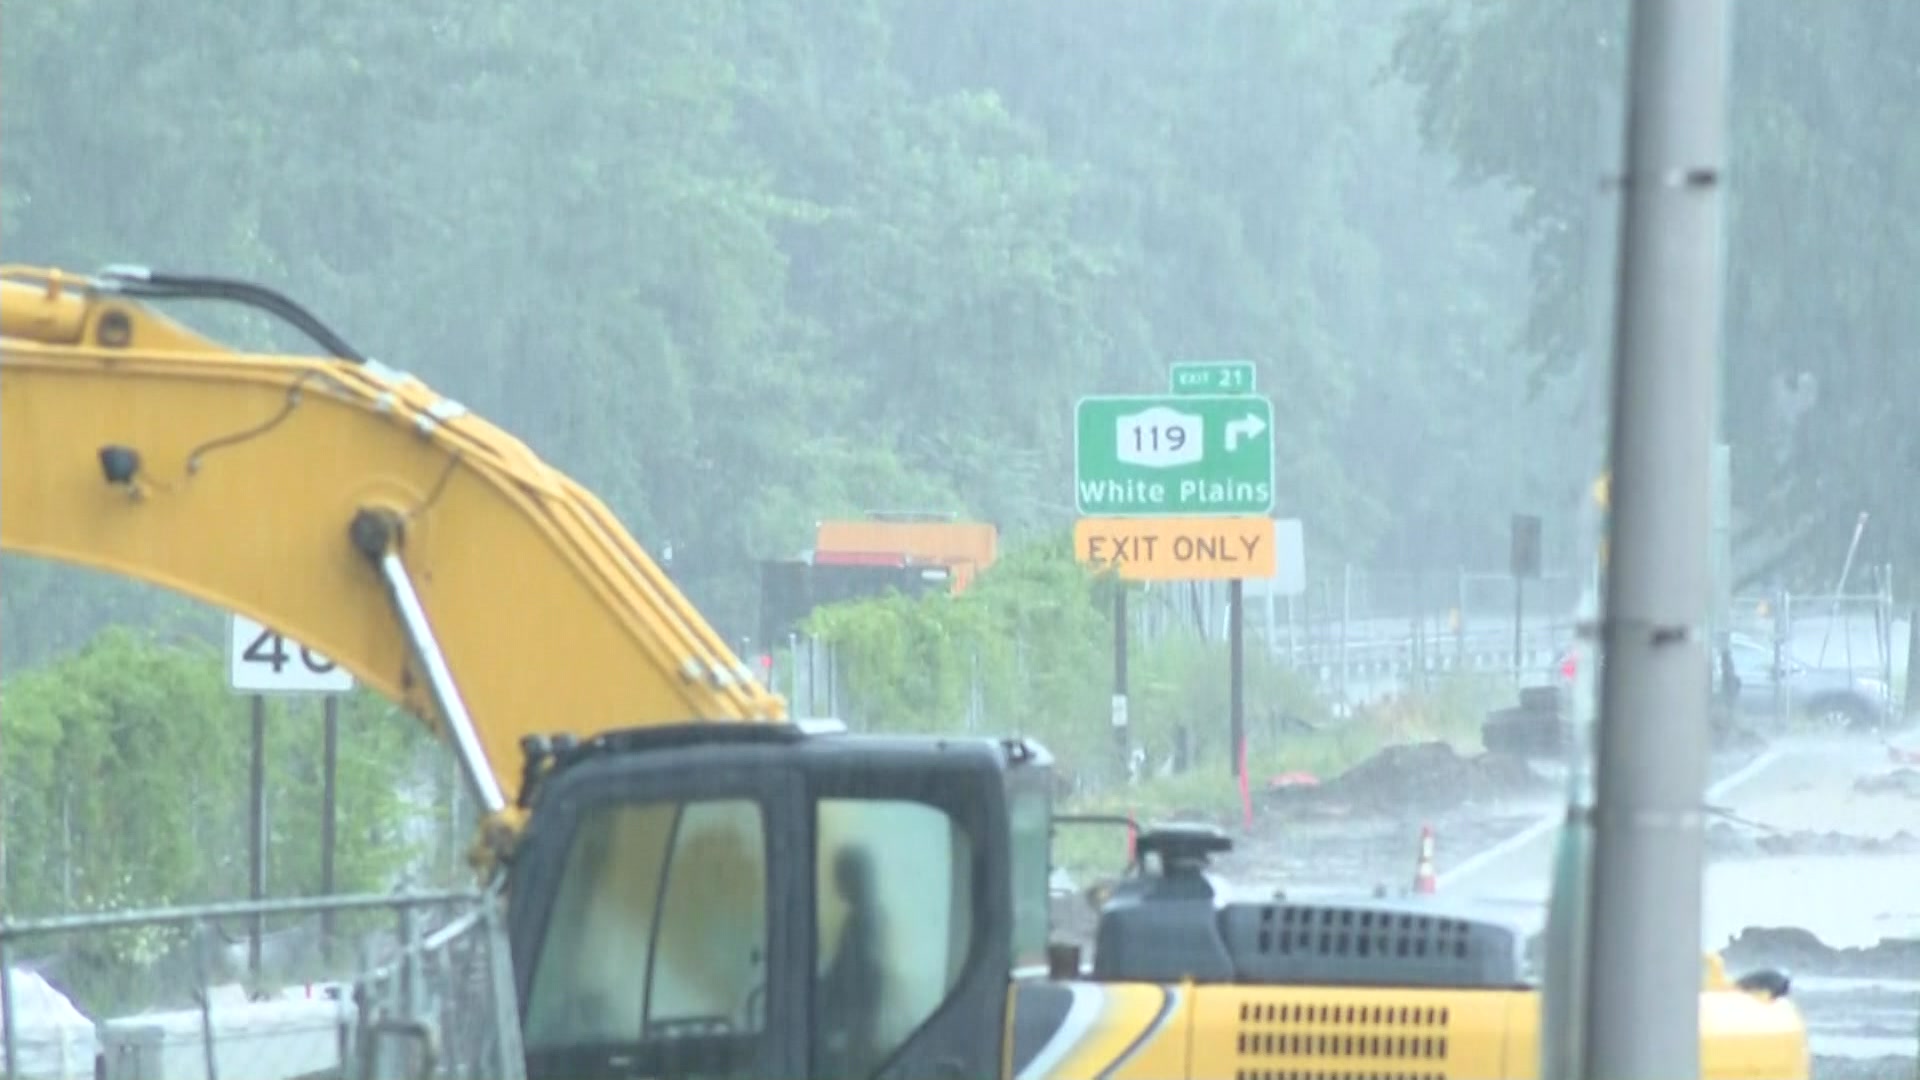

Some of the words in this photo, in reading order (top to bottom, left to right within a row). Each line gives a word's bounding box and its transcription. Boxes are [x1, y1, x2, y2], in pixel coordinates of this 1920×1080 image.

[1180, 372, 1208, 384] EXIT
[1219, 370, 1242, 386] 21
[1133, 425, 1186, 451] 119
[1080, 479, 1164, 503] White
[1180, 479, 1269, 503] Plains
[1088, 536, 1158, 562] EXIT
[1173, 536, 1261, 562] ONLY
